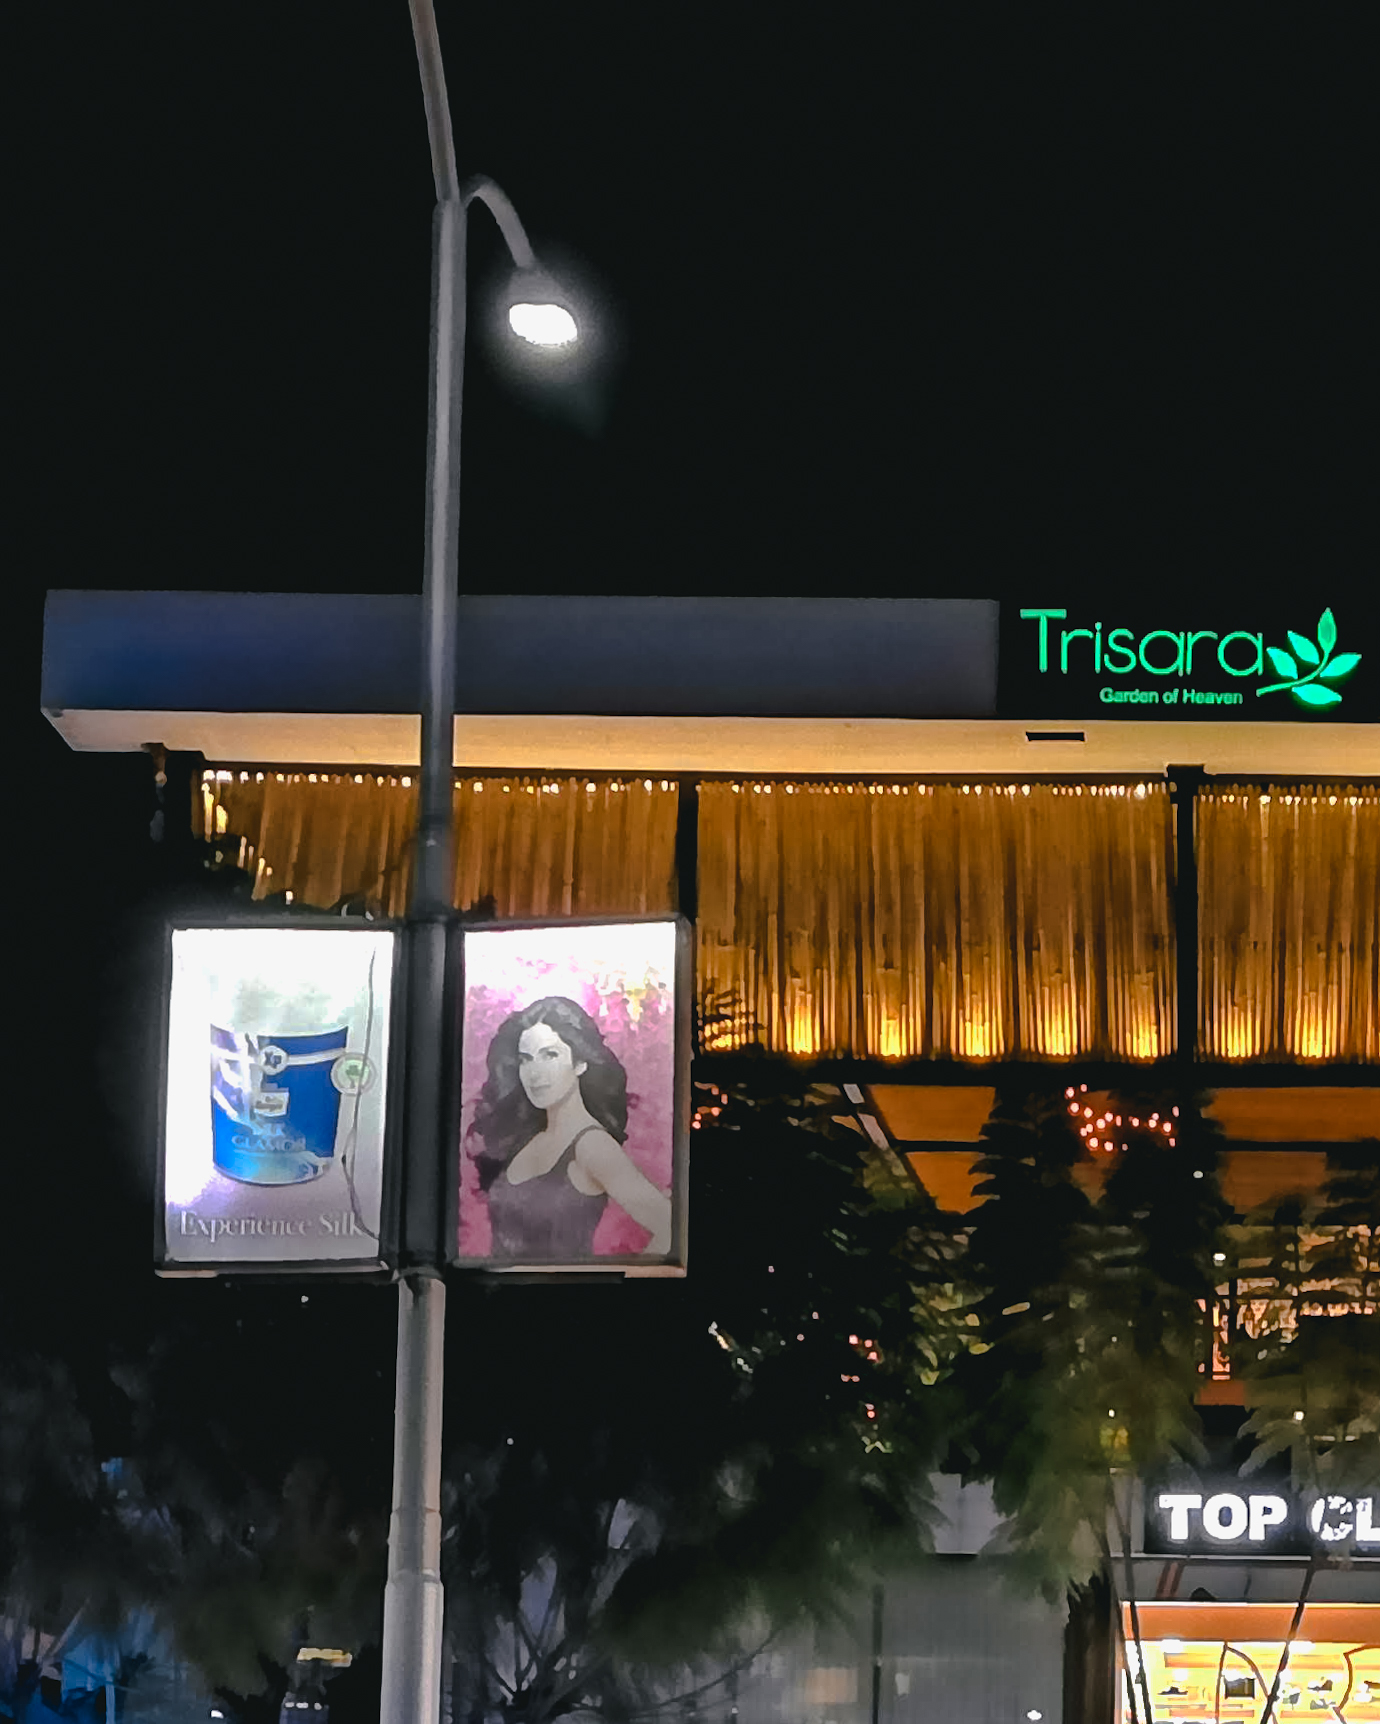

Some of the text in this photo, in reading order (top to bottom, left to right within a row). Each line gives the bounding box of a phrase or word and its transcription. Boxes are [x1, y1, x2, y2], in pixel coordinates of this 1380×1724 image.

[1019, 608, 1264, 677] Trisara
[1099, 686, 1244, 705] Garden of Heaven
[179, 1210, 365, 1243] Experience Silk
[1158, 1493, 1289, 1541] TOP
